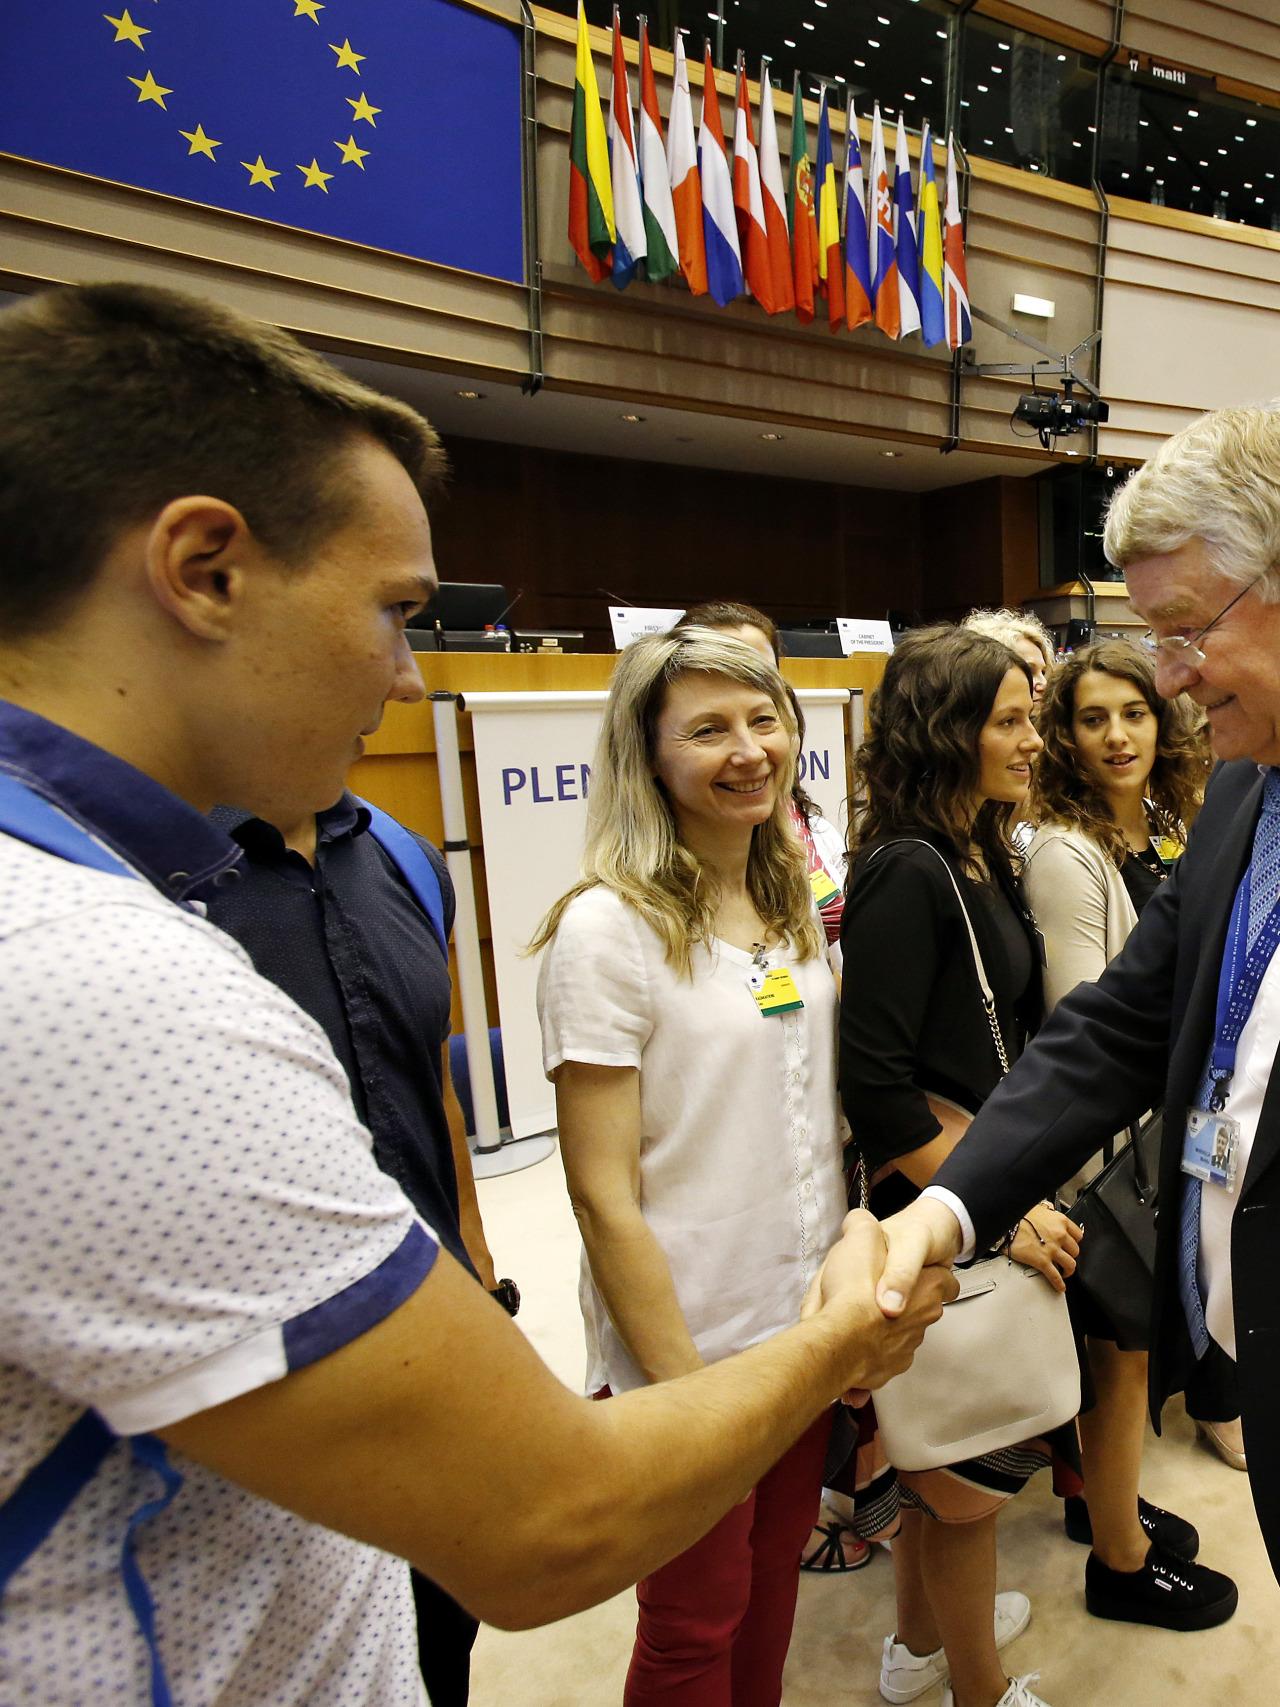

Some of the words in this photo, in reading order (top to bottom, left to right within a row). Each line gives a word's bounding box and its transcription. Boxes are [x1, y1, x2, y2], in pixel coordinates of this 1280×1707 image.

[1129, 59, 1139, 73] 17
[1152, 65, 1187, 85] malti
[1107, 466, 1114, 478] 6
